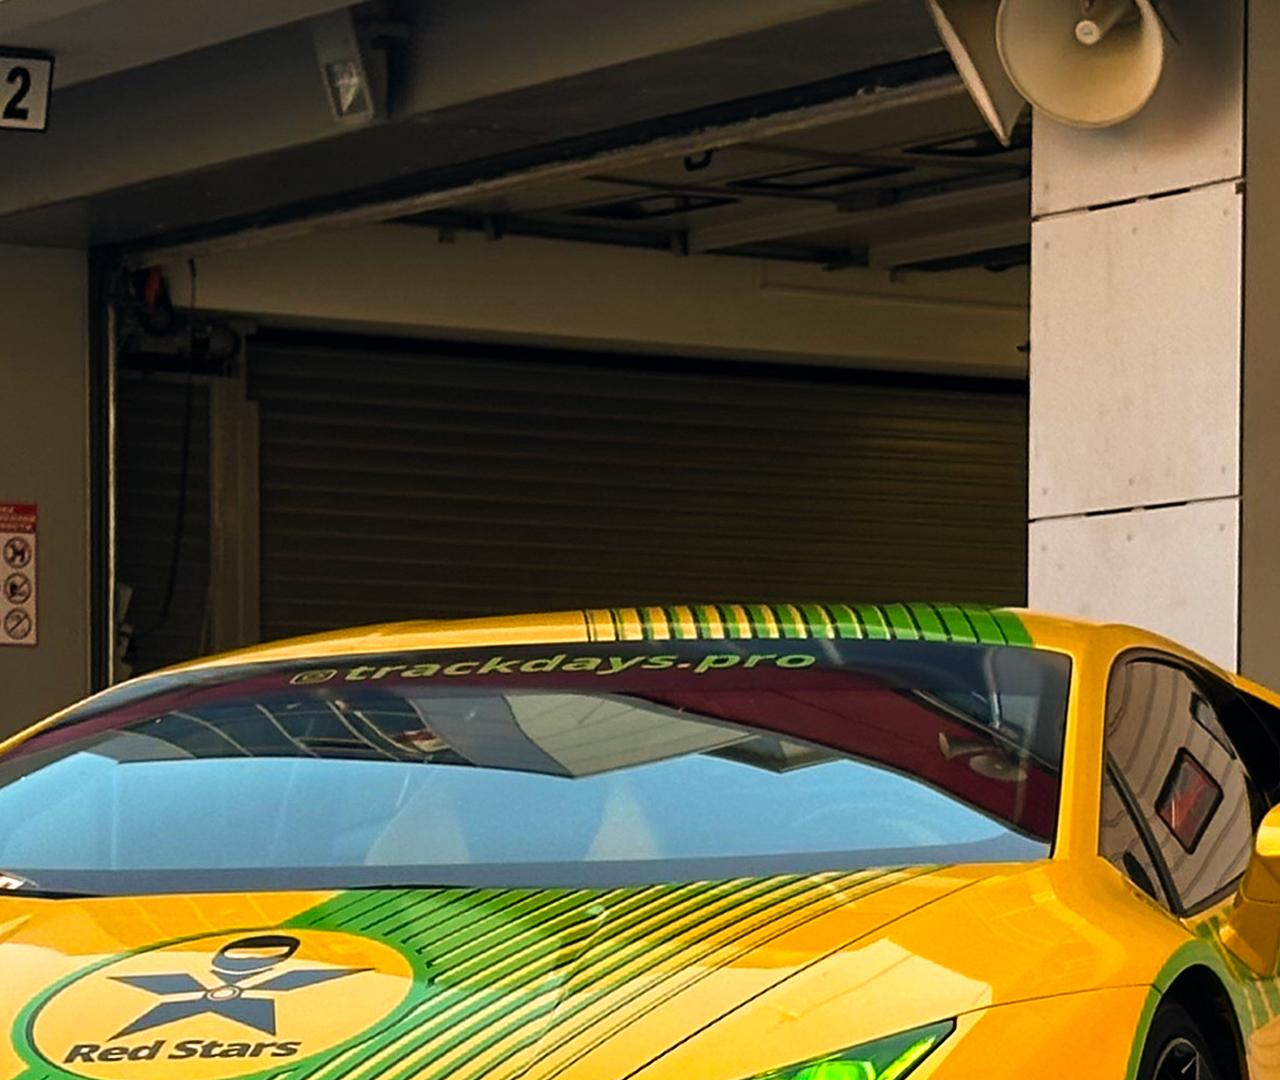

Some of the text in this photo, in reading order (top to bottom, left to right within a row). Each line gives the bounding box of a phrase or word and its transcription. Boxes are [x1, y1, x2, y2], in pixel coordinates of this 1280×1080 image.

[3, 66, 31, 120] 2
[344, 650, 817, 683] trackdays.pro
[63, 1038, 303, 1064] Red Stars
